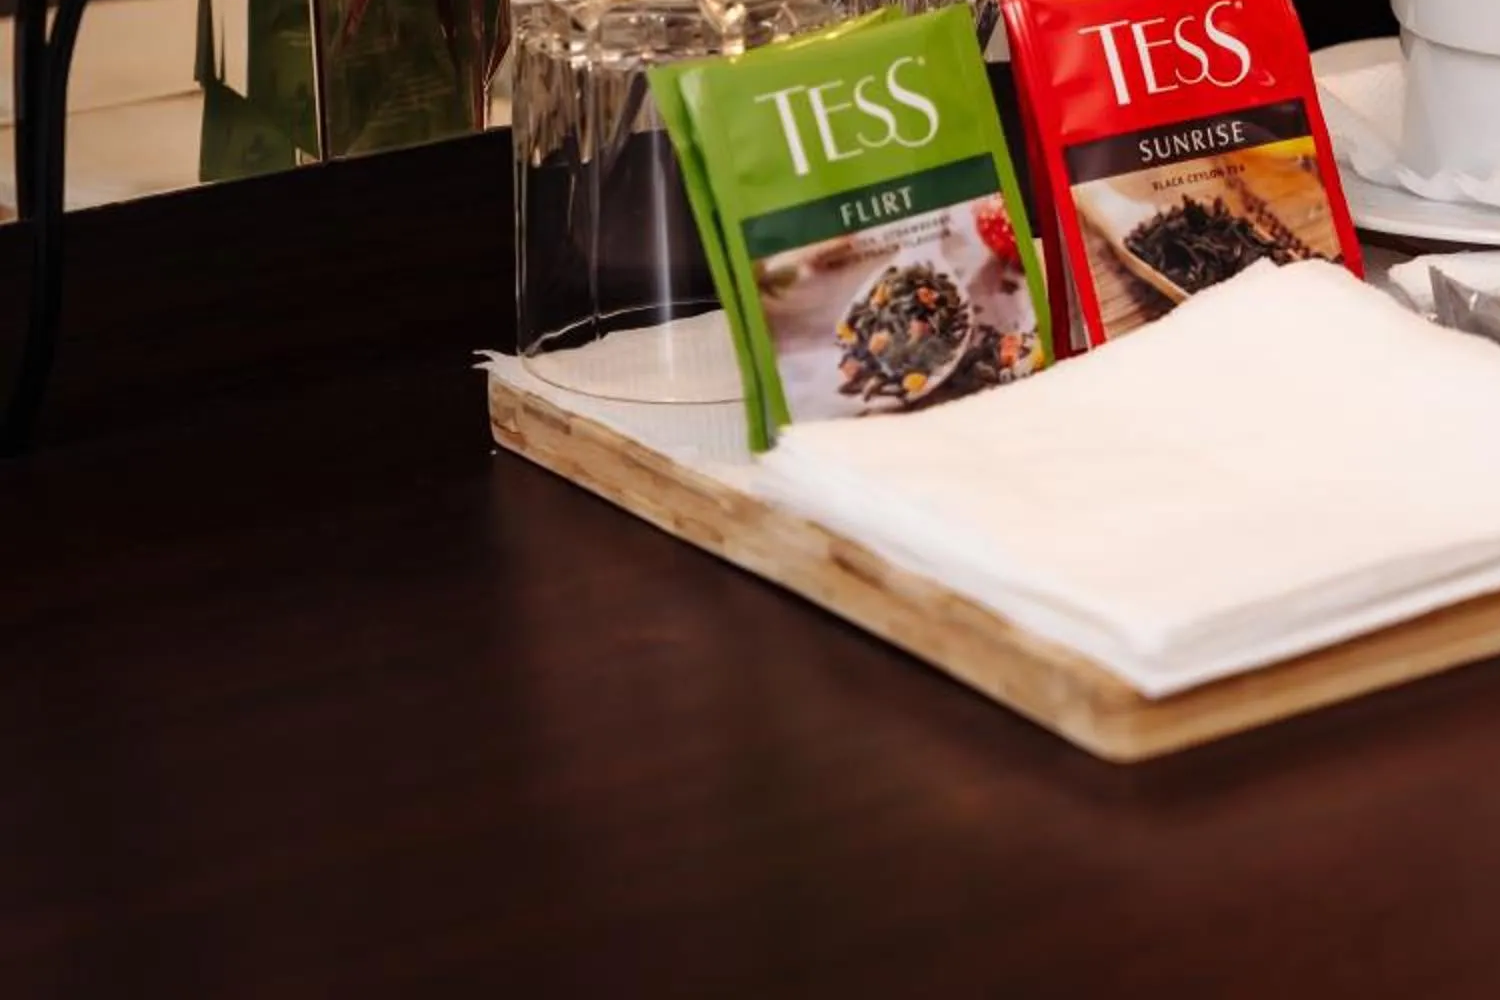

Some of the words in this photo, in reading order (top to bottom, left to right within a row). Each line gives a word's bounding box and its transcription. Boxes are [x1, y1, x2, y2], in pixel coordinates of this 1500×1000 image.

[1078, 0, 1251, 105] TESS
[754, 56, 939, 176] TESS
[1139, 121, 1245, 162] SUNRISE
[840, 186, 911, 227] FLIRT
